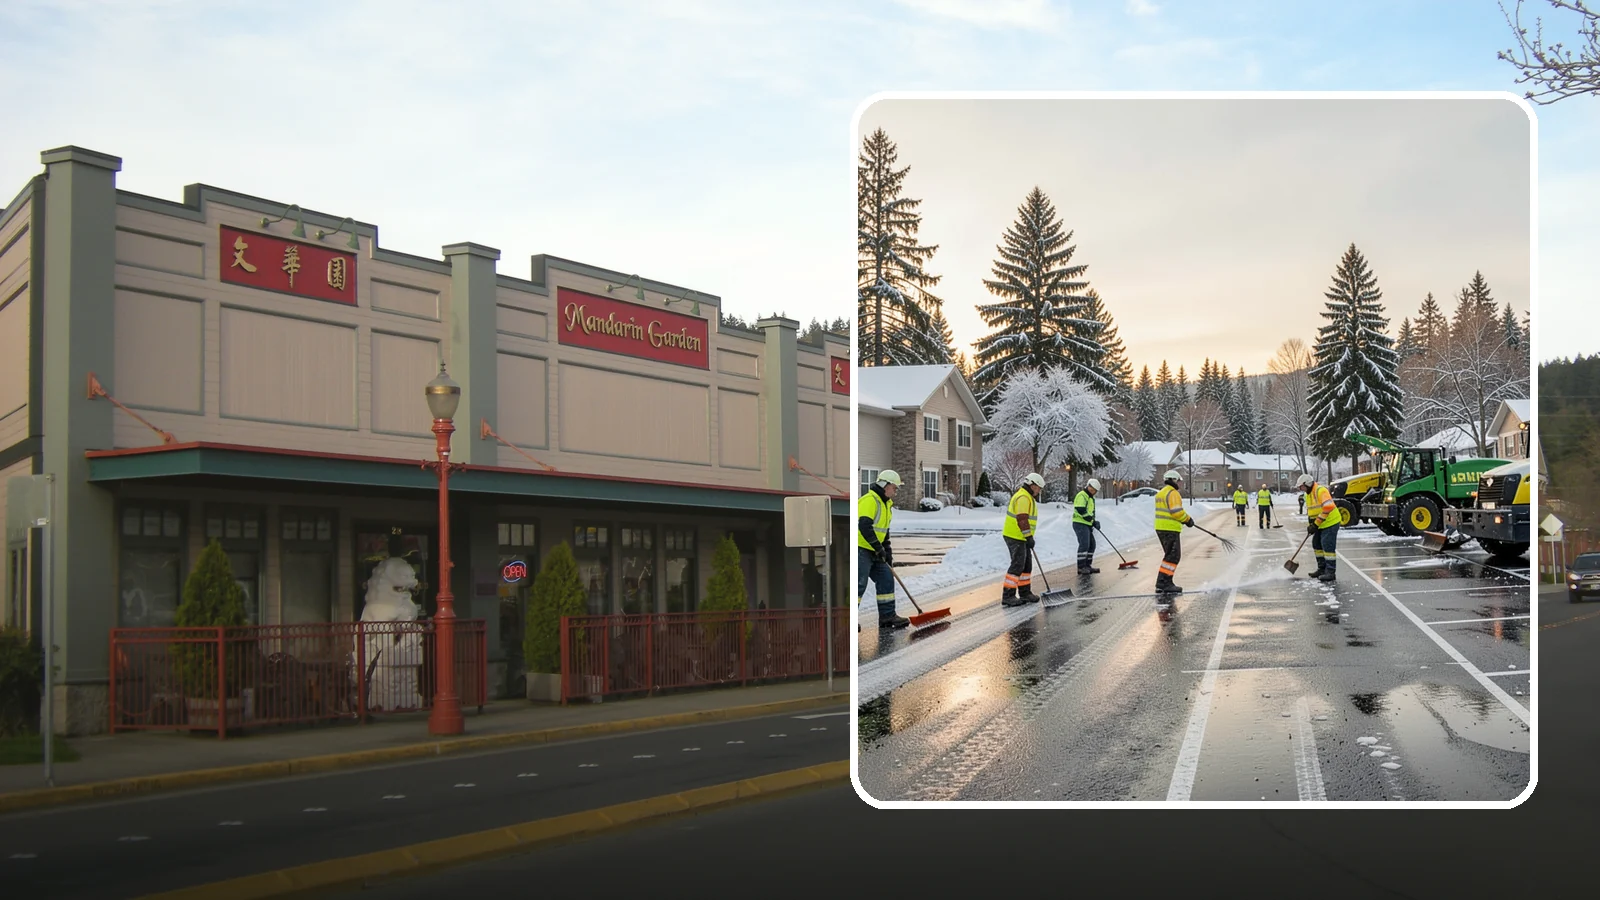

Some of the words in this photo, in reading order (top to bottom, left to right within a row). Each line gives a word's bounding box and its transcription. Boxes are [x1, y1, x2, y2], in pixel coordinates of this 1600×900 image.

[230, 235, 347, 291] 文華園
[564, 302, 644, 341] Mandarin
[647, 320, 701, 352] Garden
[834, 362, 846, 386] 文
[503, 565, 527, 578] OPEN
